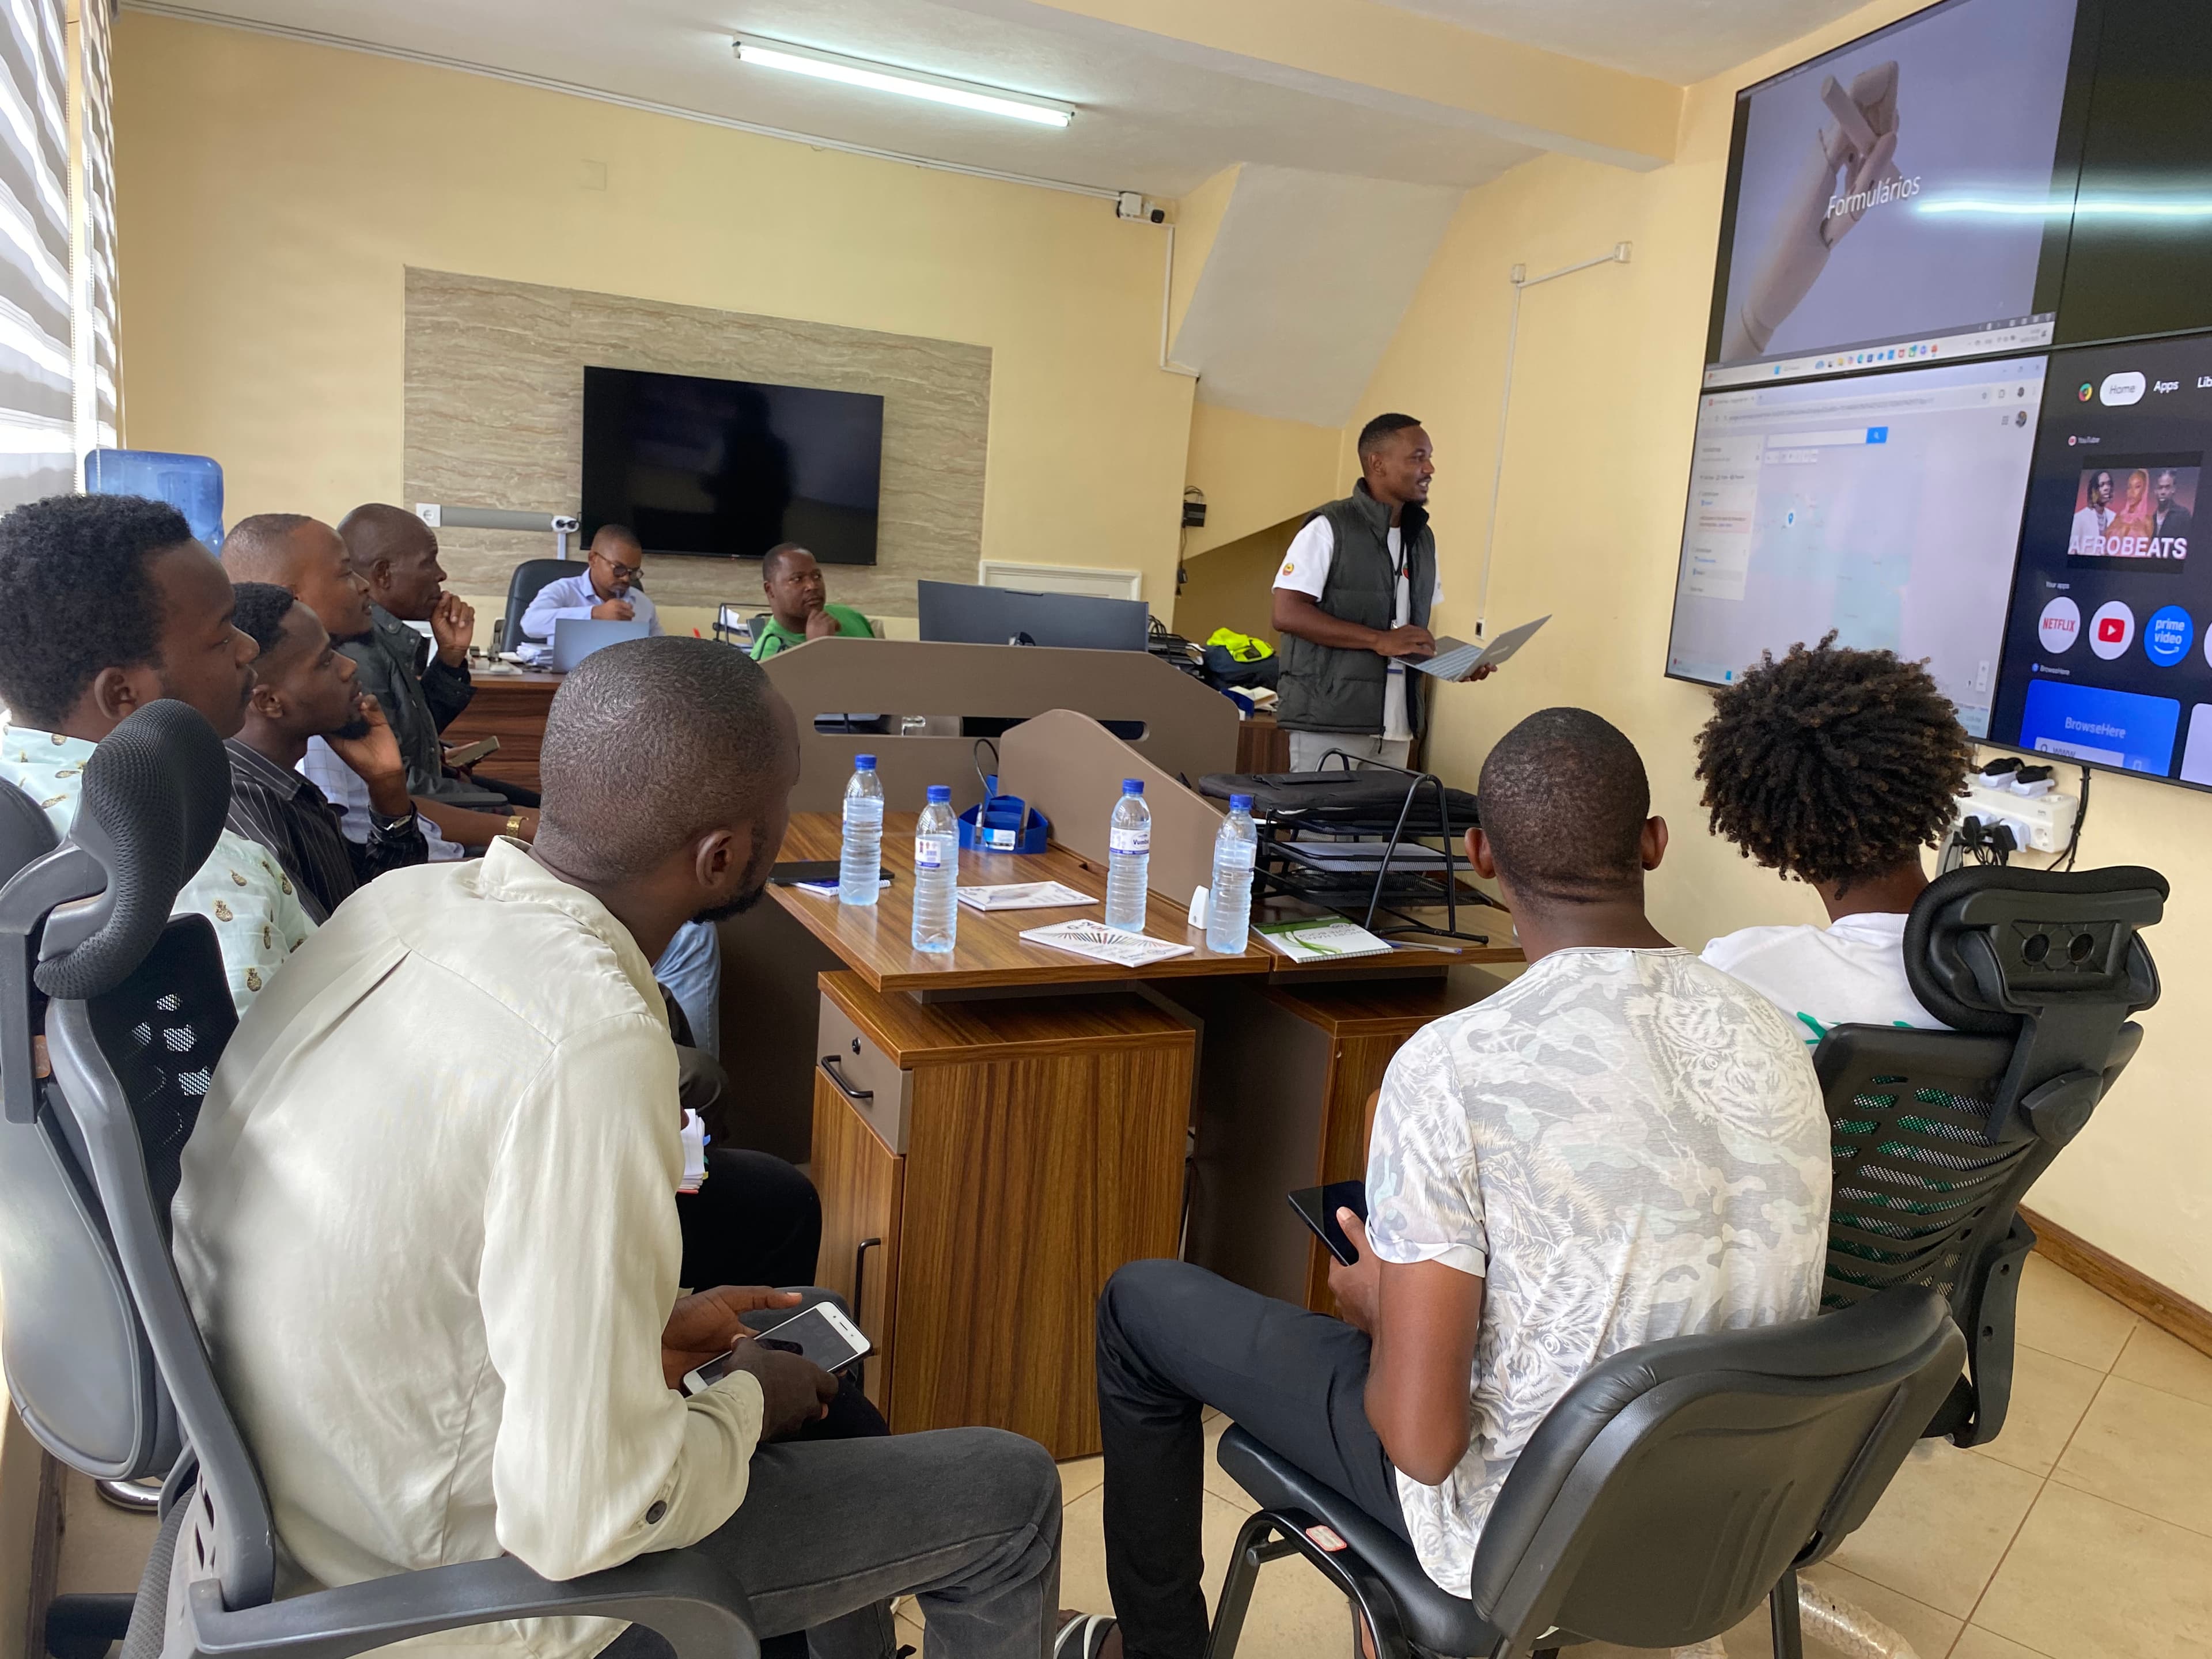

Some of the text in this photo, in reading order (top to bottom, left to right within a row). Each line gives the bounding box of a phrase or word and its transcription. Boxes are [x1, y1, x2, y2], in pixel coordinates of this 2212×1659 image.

[1828, 175, 1921, 218] Formulários
[2109, 385, 2136, 395] Home
[2153, 380, 2180, 393] Apps
[2068, 536, 2187, 559] AFROBEATS
[2043, 618, 2076, 632] NETFLIX
[2155, 618, 2185, 632] prime
[2154, 631, 2182, 645] video
[2065, 717, 2126, 738] BrowseHere
